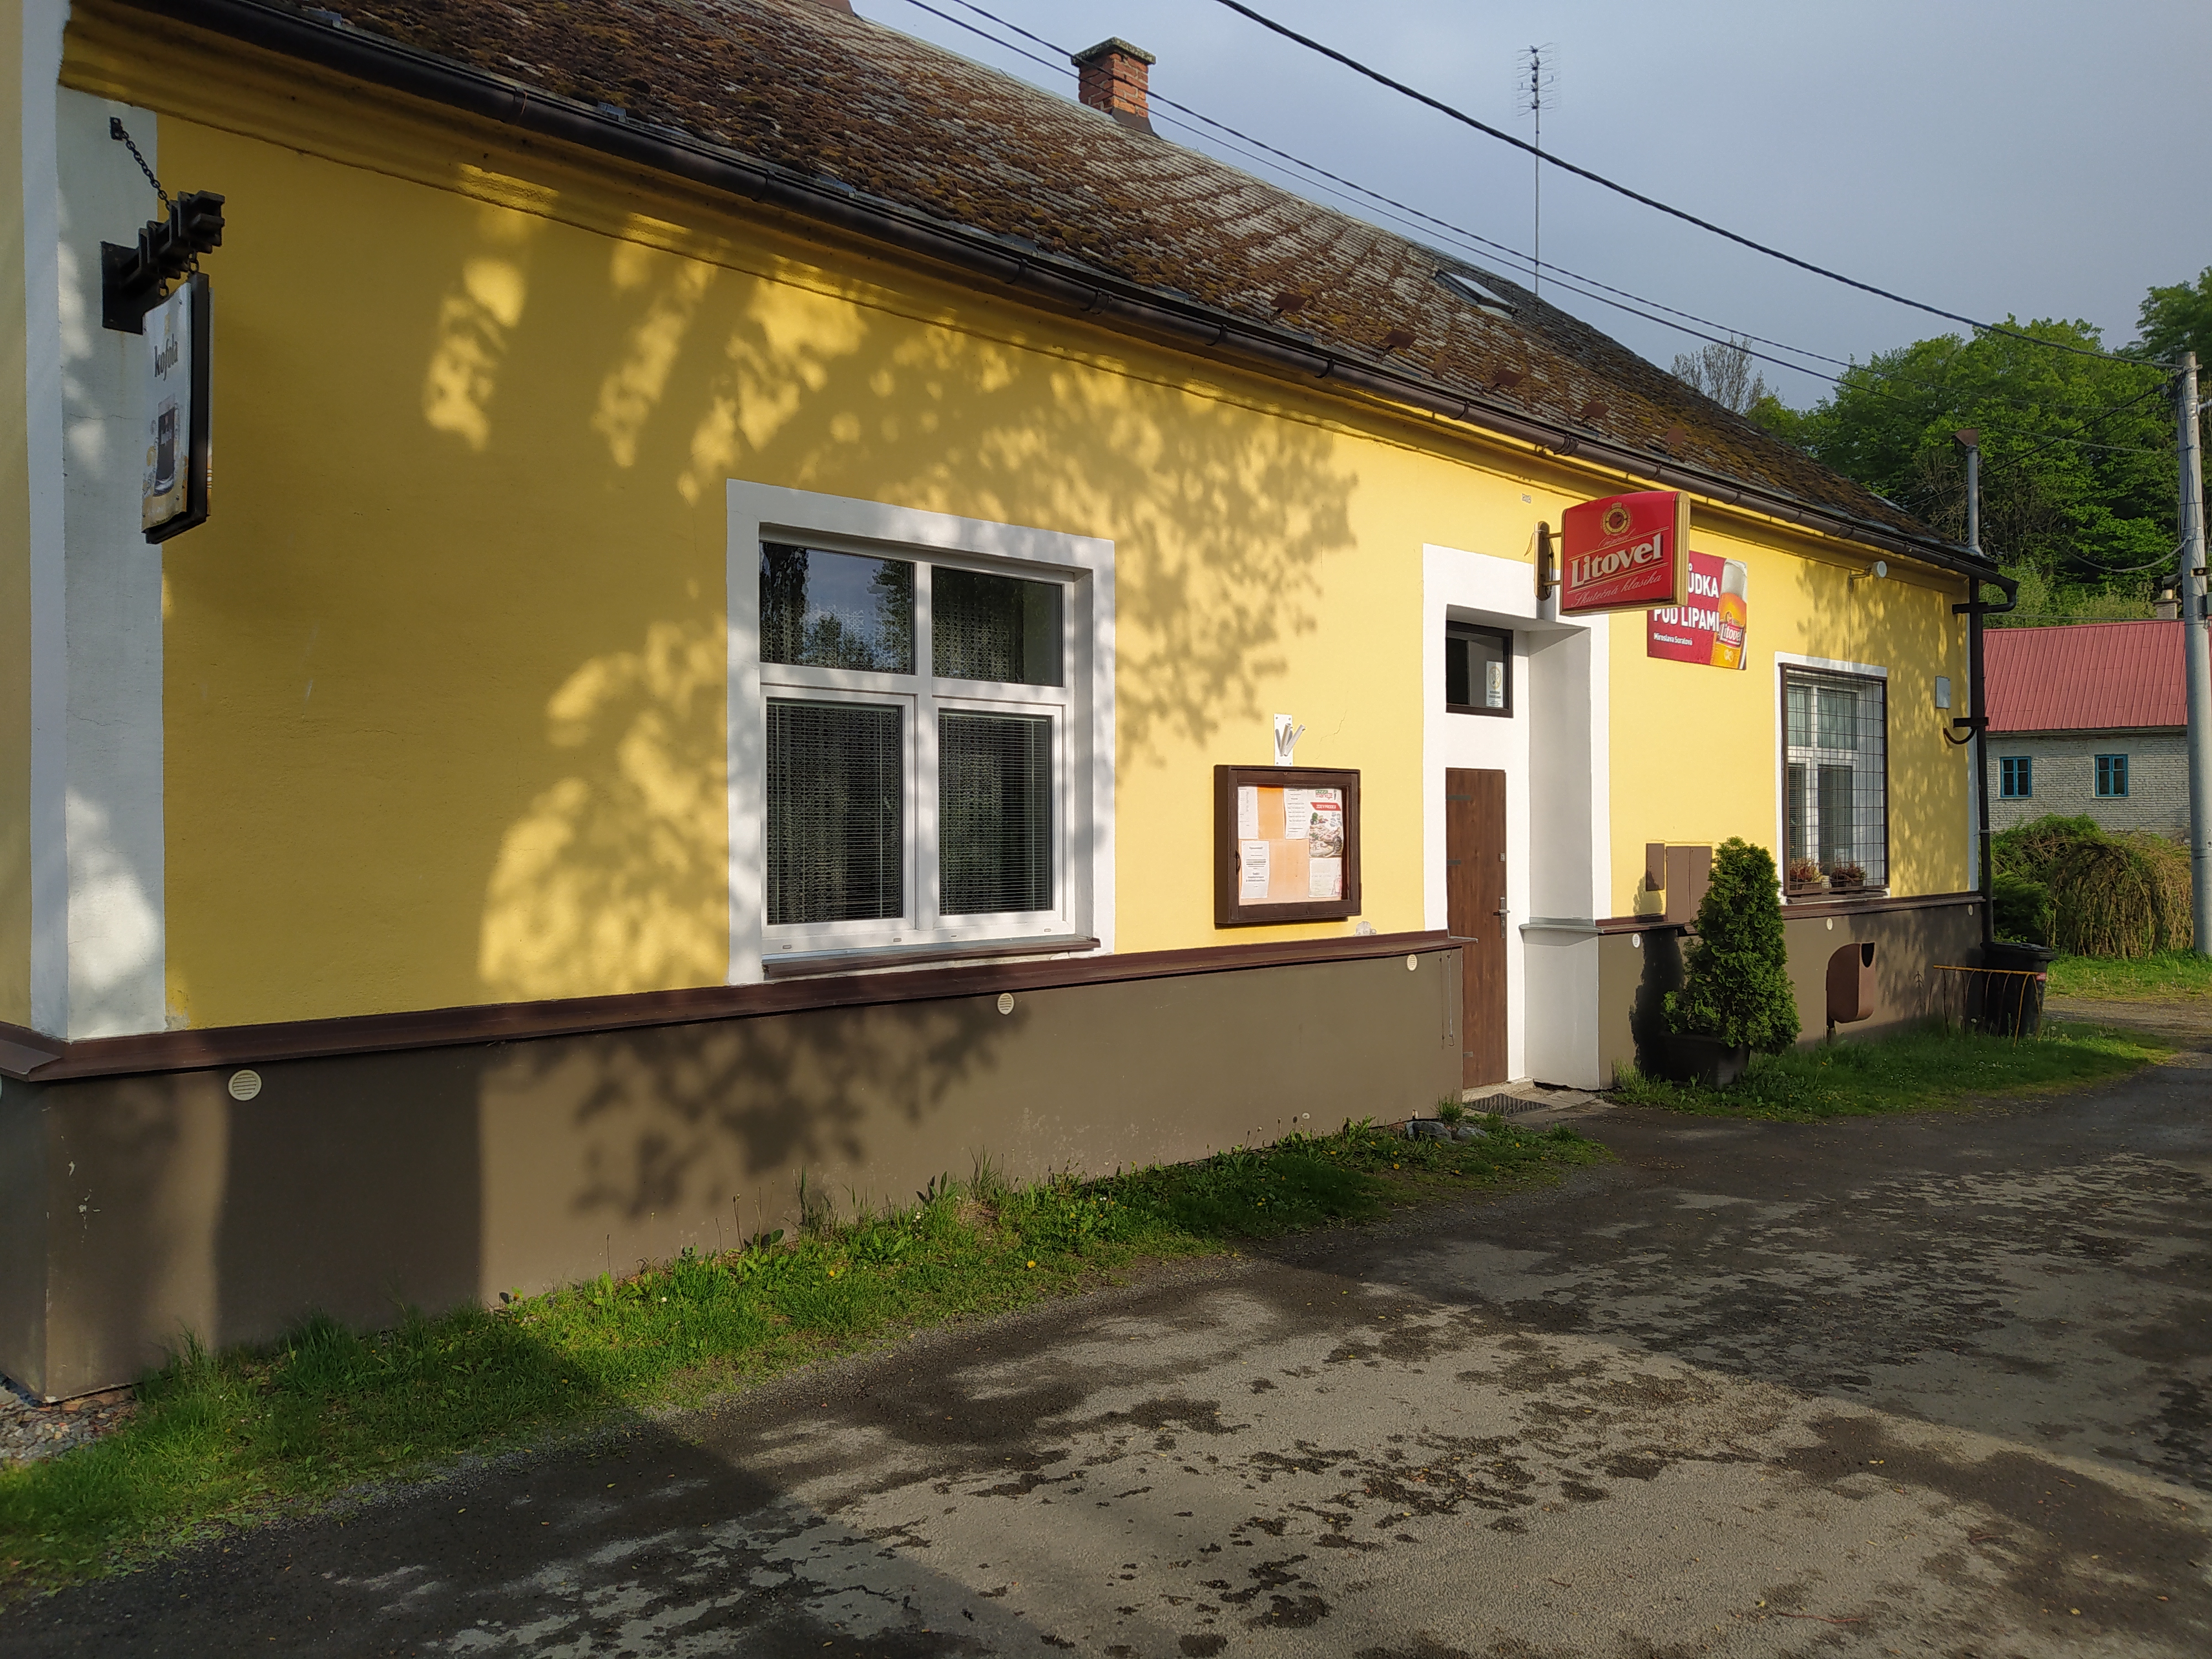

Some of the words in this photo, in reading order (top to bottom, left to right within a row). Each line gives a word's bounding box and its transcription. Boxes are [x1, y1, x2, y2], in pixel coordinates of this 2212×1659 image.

[1569, 532, 1663, 588] Litovel
[1571, 585, 1619, 607] Skutečná
[1620, 570, 1663, 593] klasika
[1681, 606, 1720, 632] LIPAMI
[1653, 632, 1674, 643] Miroslava
[1719, 623, 1743, 642] Litovel
